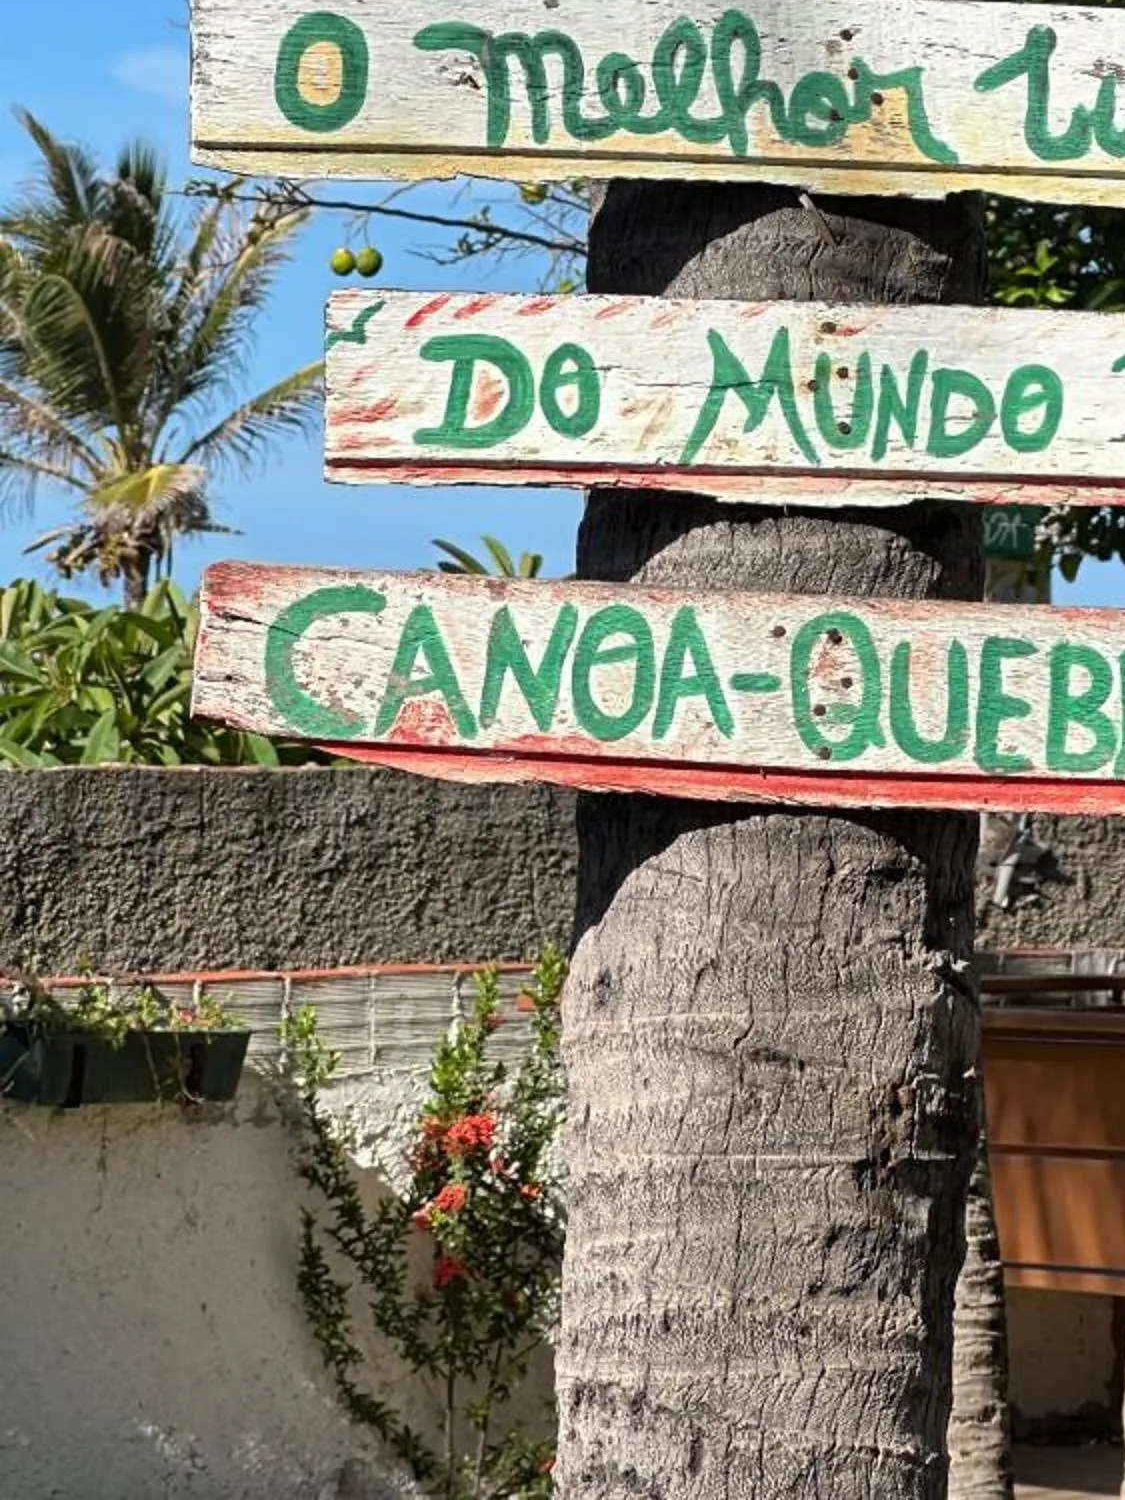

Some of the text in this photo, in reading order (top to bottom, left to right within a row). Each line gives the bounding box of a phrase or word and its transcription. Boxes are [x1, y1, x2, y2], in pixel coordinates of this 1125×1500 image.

[277, 11, 370, 133] O
[412, 326, 1063, 466] DO MUNDO
